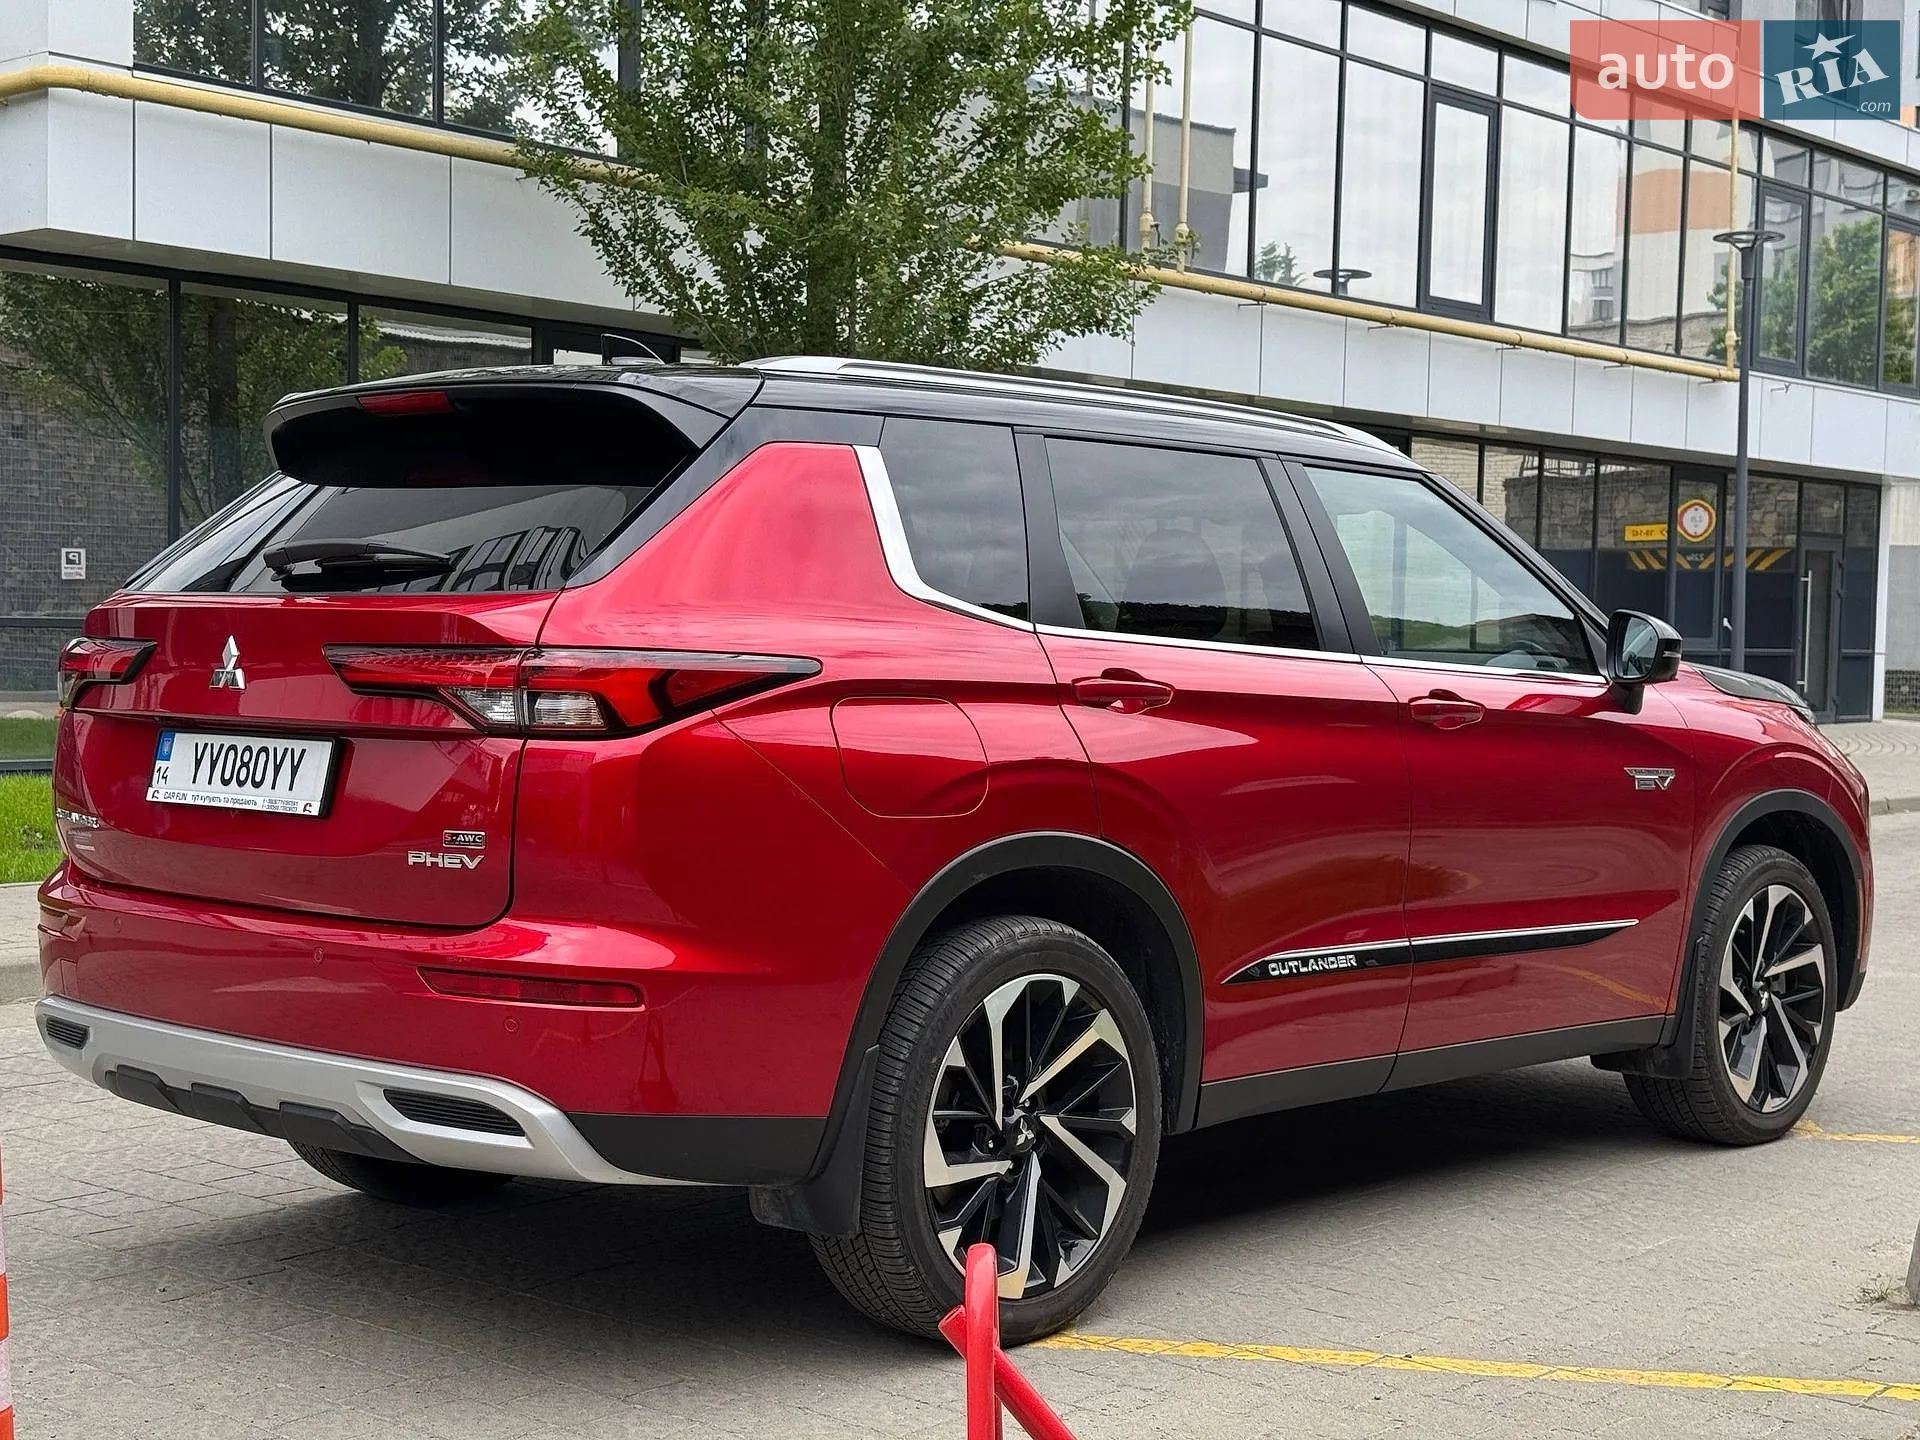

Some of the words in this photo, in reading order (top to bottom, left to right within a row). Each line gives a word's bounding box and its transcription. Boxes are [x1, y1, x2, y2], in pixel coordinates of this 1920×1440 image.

[156, 766, 170, 785] 14
[191, 742, 307, 792] YY080YY
[163, 791, 176, 800] CAR
[176, 792, 188, 801] FUN
[445, 833, 484, 842] S-AWC
[407, 850, 485, 869] PHEV
[1268, 954, 1358, 977] OUTLANDER
